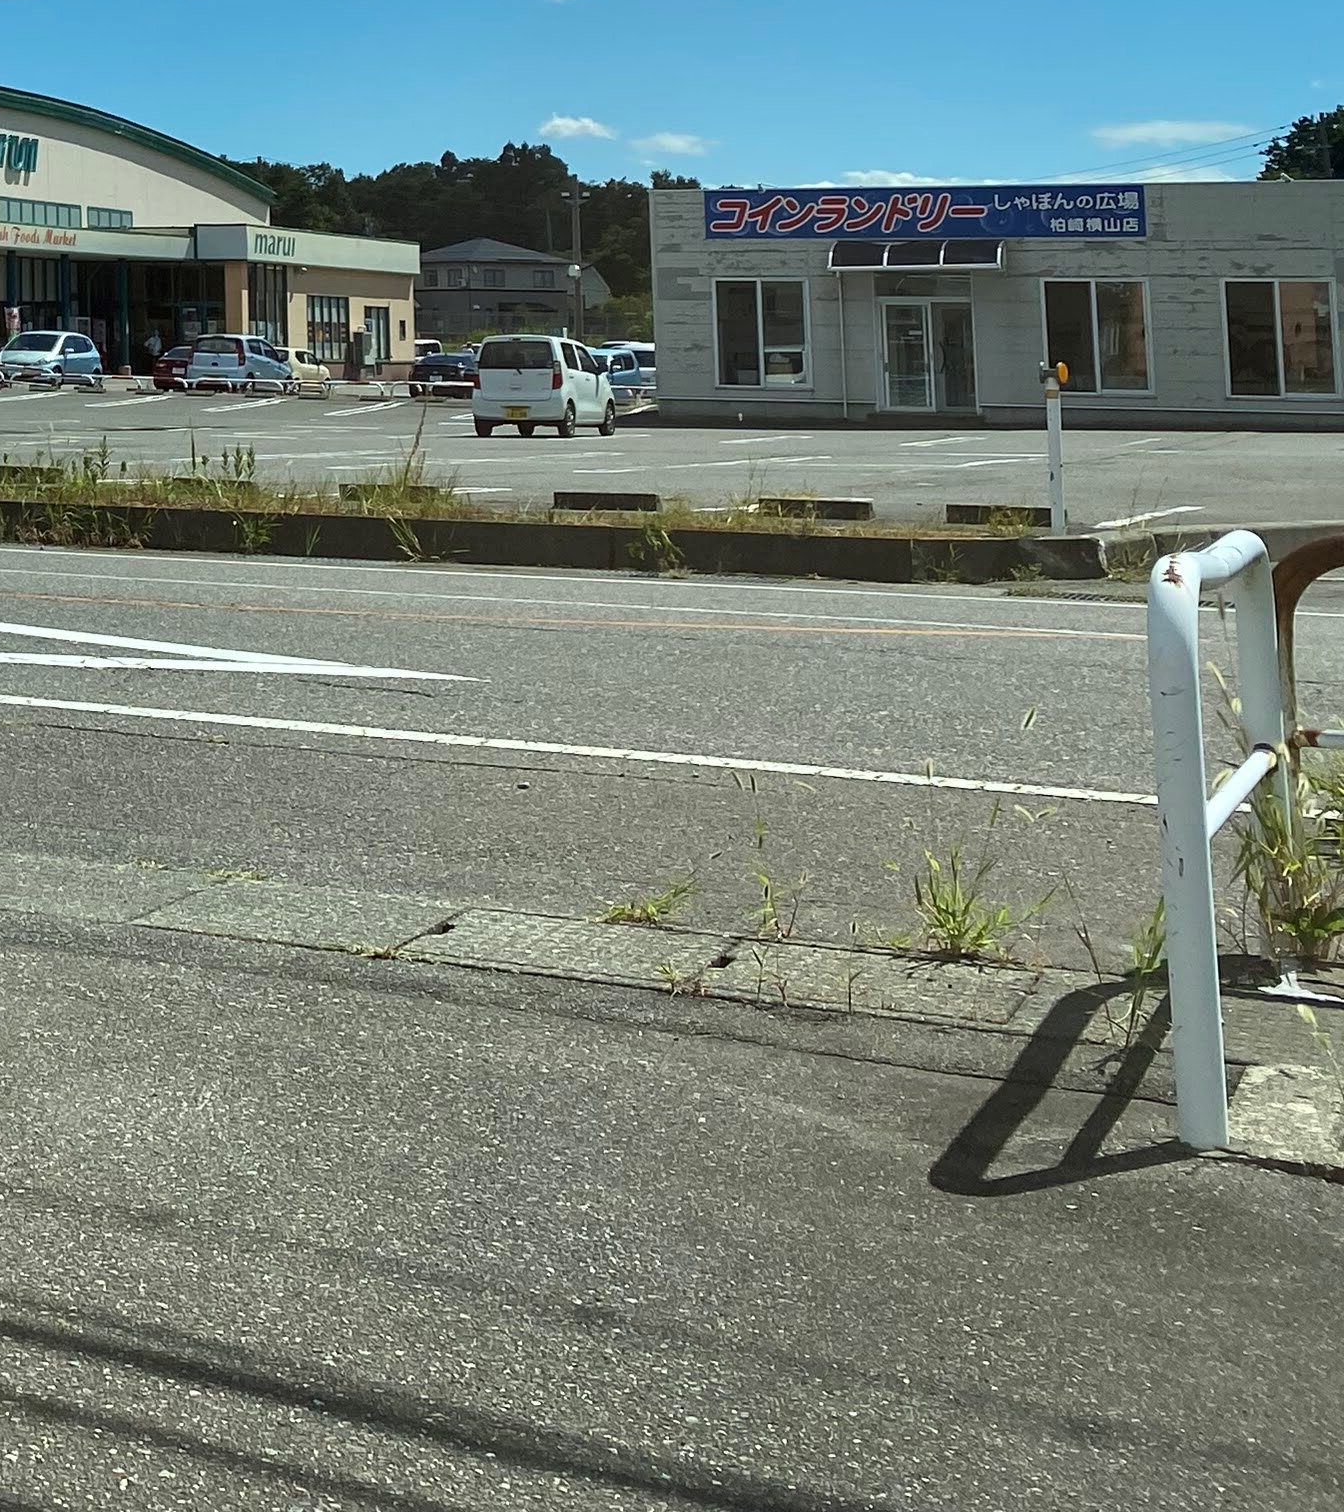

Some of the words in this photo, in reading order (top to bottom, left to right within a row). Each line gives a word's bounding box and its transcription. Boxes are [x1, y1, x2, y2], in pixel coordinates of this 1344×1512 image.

[710, 193, 988, 234] コインランドリー
[993, 192, 1140, 211] しゃぼんの広場
[11, 225, 41, 246] Foods
[44, 228, 78, 247] Market
[1049, 217, 1140, 233] 柏崎横山店
[254, 233, 296, 257] marui
